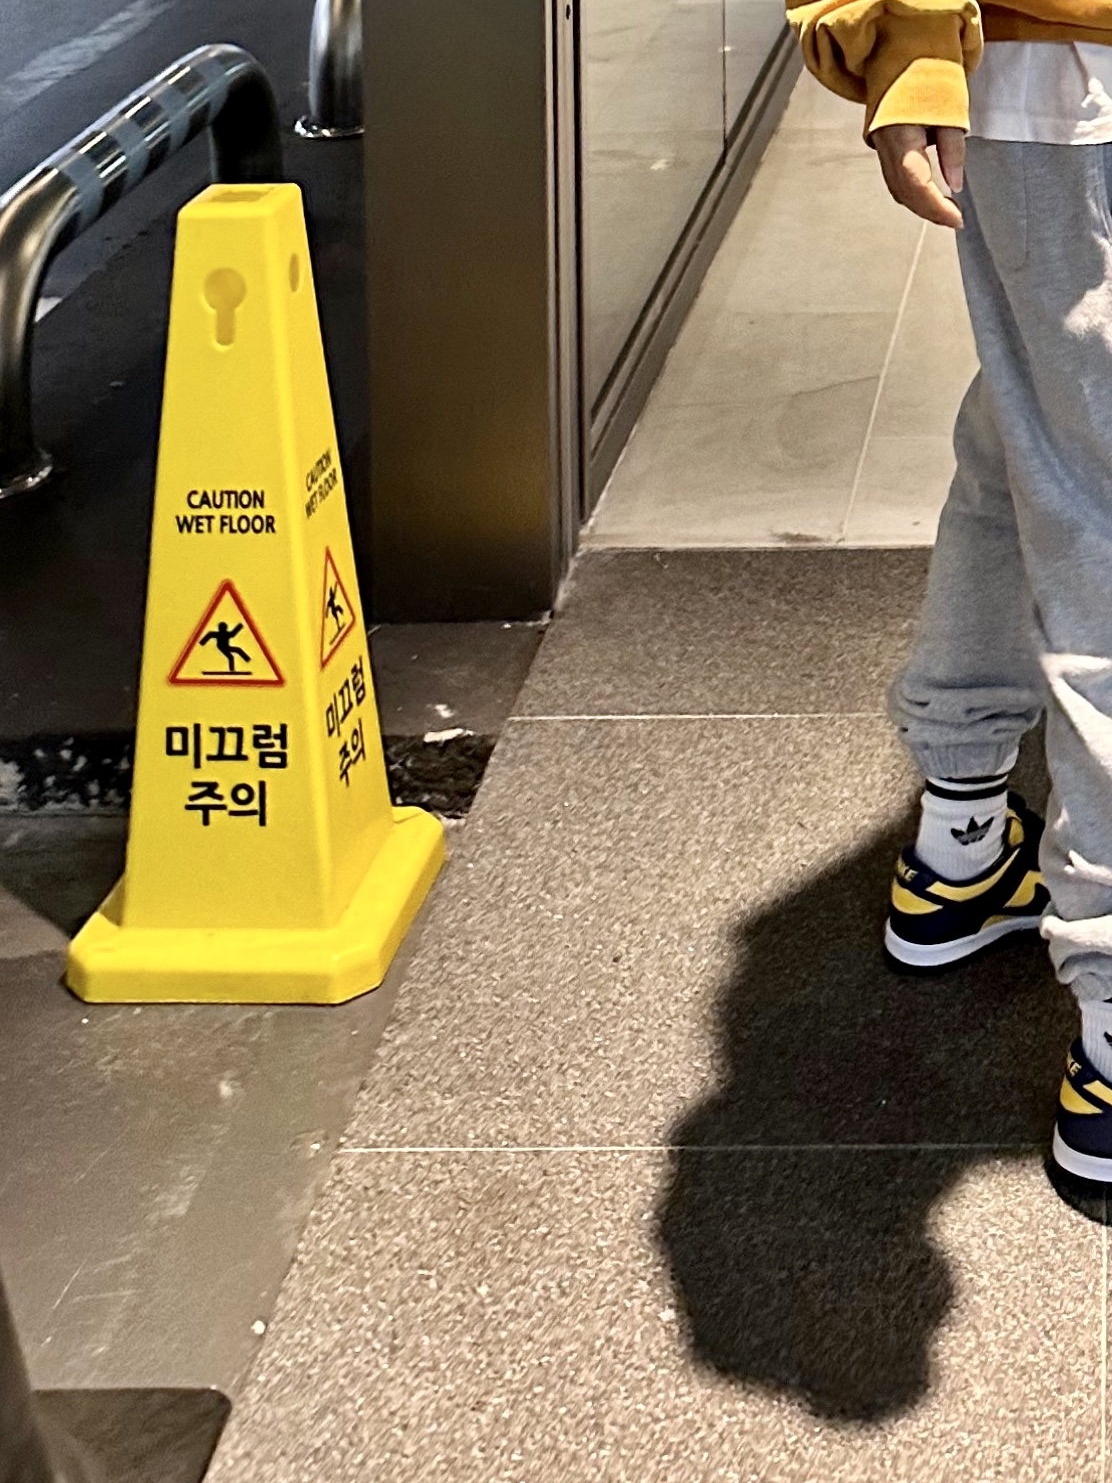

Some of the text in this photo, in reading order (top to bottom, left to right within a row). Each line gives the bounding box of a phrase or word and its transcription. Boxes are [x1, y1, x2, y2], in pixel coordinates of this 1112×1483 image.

[187, 489, 265, 509] CAUTION
[175, 514, 276, 534] WET FLOOR
[325, 655, 366, 738] 미끄럼
[165, 722, 288, 769] 미끄럼
[338, 717, 366, 788] 주의
[184, 780, 267, 827] 주의
